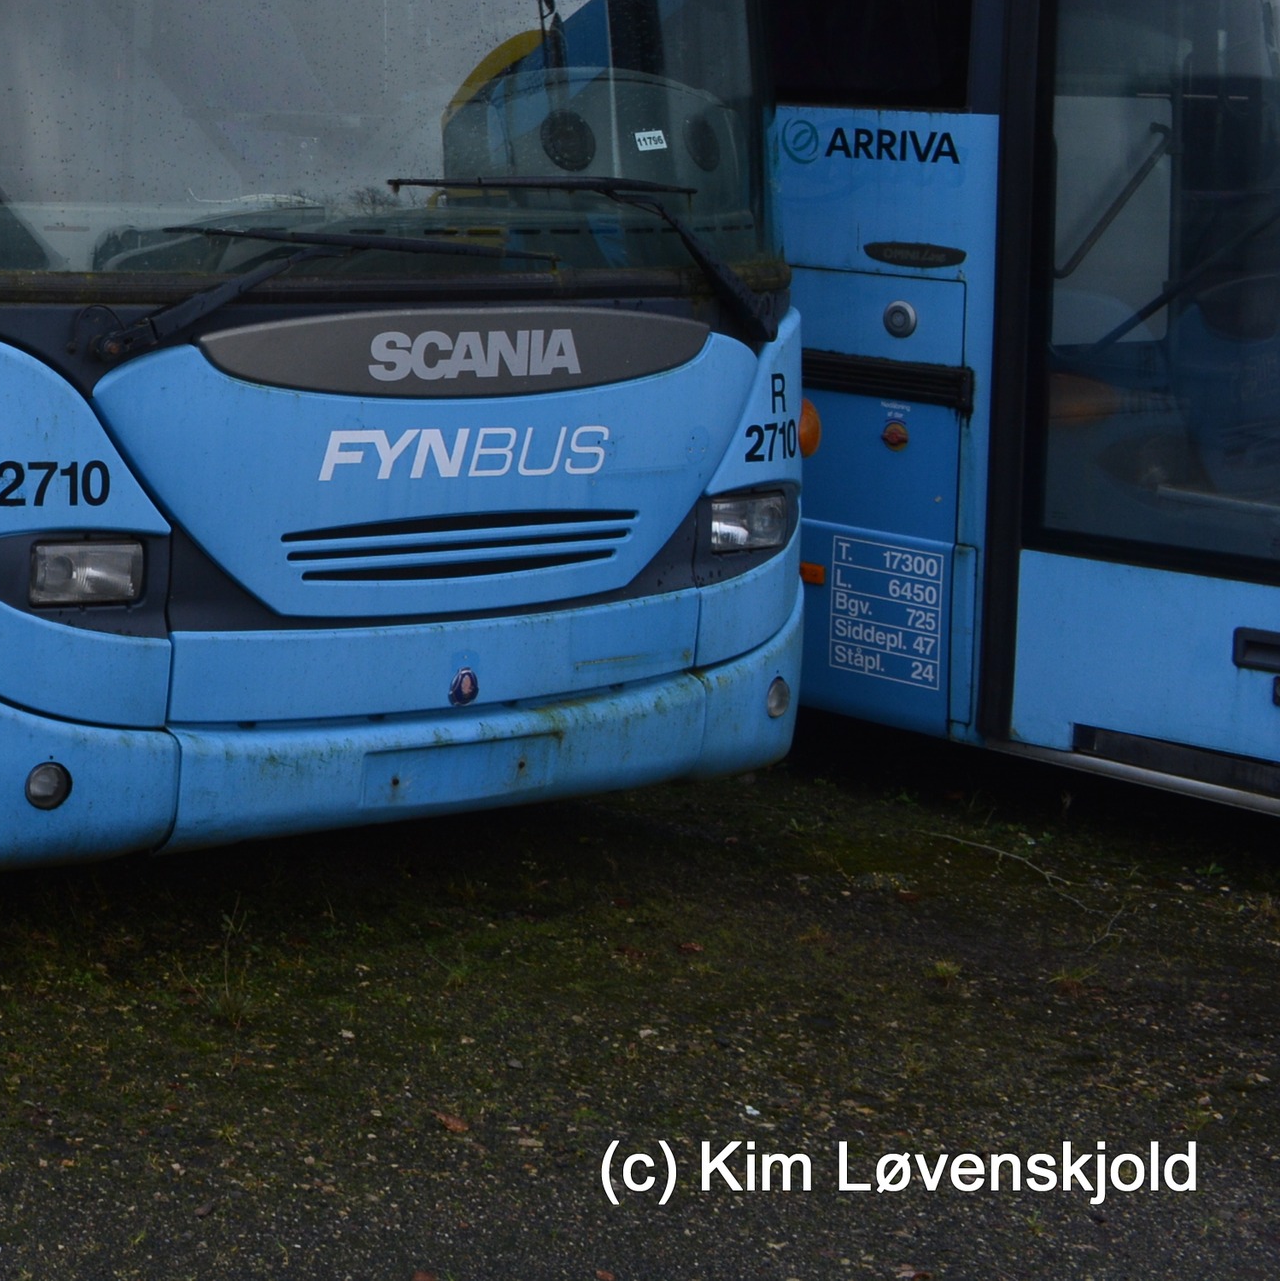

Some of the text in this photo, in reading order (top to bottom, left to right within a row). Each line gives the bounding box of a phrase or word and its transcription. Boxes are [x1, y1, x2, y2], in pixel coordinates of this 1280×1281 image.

[825, 127, 960, 164] ARRIVA
[368, 329, 581, 381] SCANIA
[771, 372, 786, 414] R
[318, 426, 609, 481] FYNBUS
[745, 419, 796, 462] 2710
[838, 542, 938, 577] T. 17300
[836, 569, 937, 605] L. 6450
[835, 592, 936, 631] Bgv. 725
[835, 619, 935, 655] Siddepl. 47
[835, 644, 934, 682] Ståpl. 24
